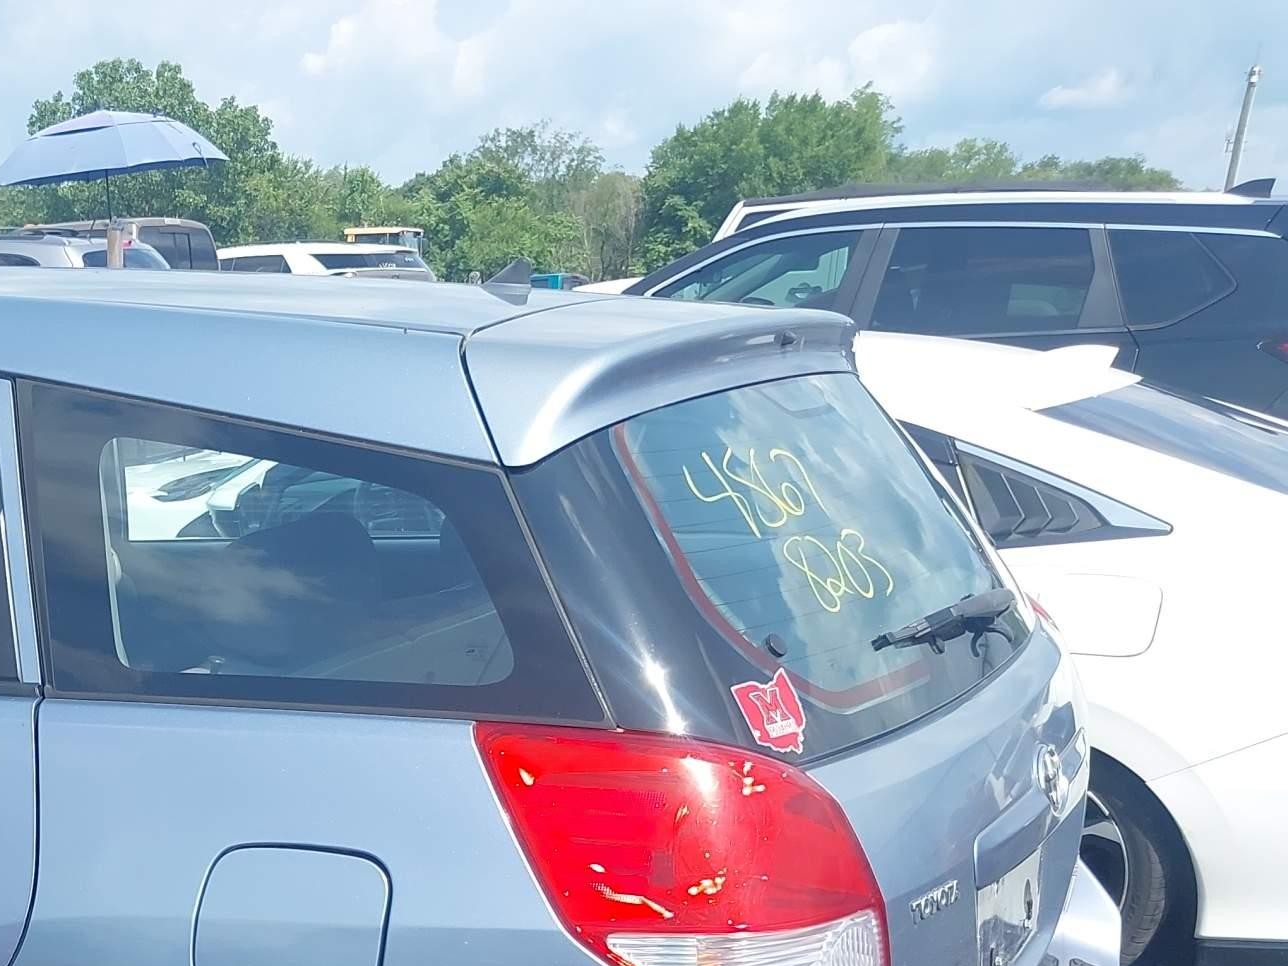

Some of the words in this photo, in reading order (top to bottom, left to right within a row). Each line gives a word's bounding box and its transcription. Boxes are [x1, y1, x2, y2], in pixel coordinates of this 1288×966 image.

[682, 448, 832, 539] 4567
[783, 528, 894, 613] 8203
[748, 687, 793, 726] M
